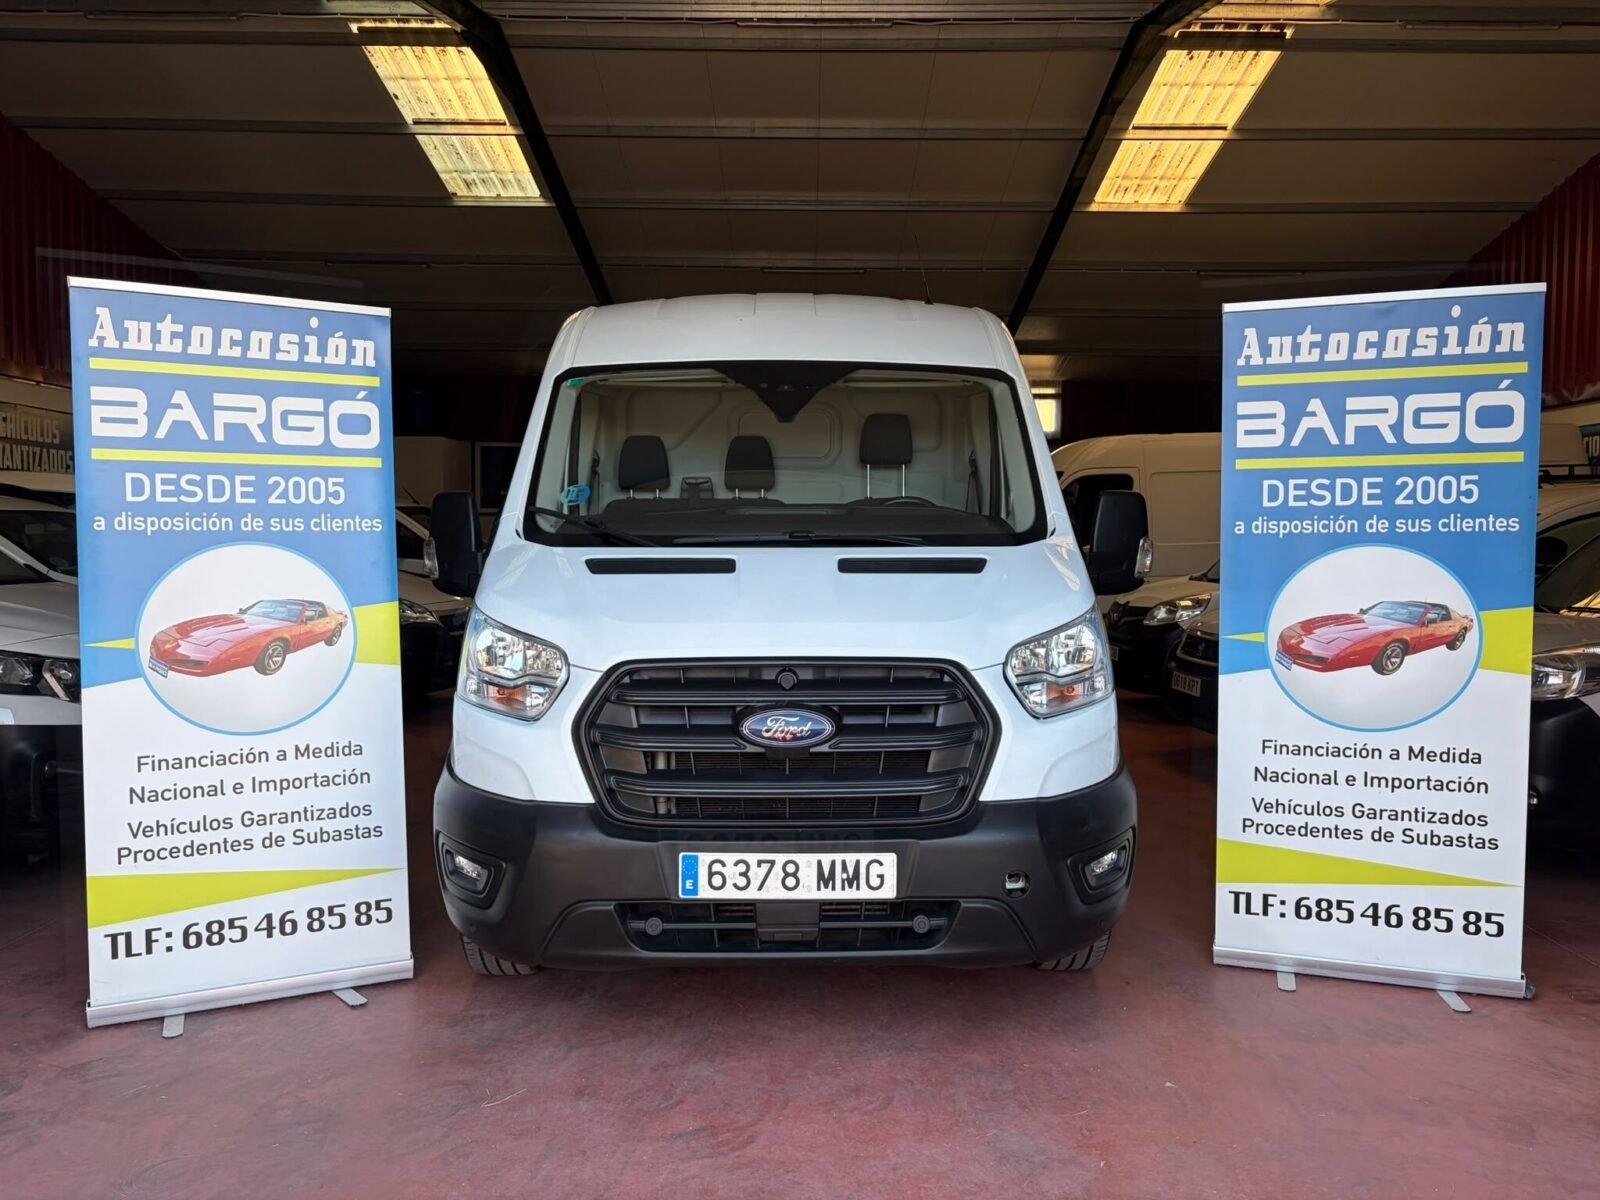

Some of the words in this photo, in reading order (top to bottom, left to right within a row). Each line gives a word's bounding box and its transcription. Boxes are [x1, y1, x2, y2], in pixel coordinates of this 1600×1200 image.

[88, 307, 375, 367] Autocasión
[1237, 305, 1524, 366] Autocasión
[90, 386, 380, 449] BARGÓ
[1236, 380, 1524, 448] BARGÓ
[126, 473, 256, 503] DESDE
[268, 476, 345, 504] 2005
[1263, 478, 1383, 507] DESDE
[1395, 475, 1478, 504] 2005
[94, 517, 105, 530] a
[115, 512, 232, 535] disposición
[241, 513, 263, 531] de
[270, 518, 304, 531] sus
[311, 514, 382, 531] clientes
[1235, 521, 1244, 534] a
[1252, 515, 1357, 538] disposición
[1366, 515, 1388, 532] de
[1396, 519, 1431, 532] sus
[1438, 514, 1519, 531] clientes
[761, 717, 810, 739] Ford
[137, 747, 269, 772] Financiación
[277, 750, 286, 761] a
[295, 741, 362, 760] Medida
[1262, 740, 1382, 759] Financiación
[1389, 749, 1399, 760] a
[1409, 746, 1481, 764] Medida
[130, 779, 226, 804] Nacional
[233, 783, 244, 794] e
[252, 768, 370, 795] Importación
[1255, 767, 1338, 785] Nacional
[1346, 775, 1356, 786] e
[1364, 772, 1488, 794] Importación
[128, 815, 233, 839] Vehículos
[241, 802, 372, 827] Garantizados
[1252, 797, 1344, 817] Vehículos
[1352, 803, 1488, 827] Garantizados
[118, 838, 254, 865] Procedentes
[262, 832, 285, 848] de
[293, 825, 383, 845] Subastas
[1243, 818, 1363, 840] Procedentes
[1371, 827, 1394, 842] de
[1402, 828, 1498, 850] Subastas
[686, 880, 693, 889] E
[708, 859, 800, 891] 6378
[817, 859, 884, 891] MMG
[104, 928, 172, 959] TLF:
[183, 917, 247, 949] 685
[254, 910, 297, 938] 46
[307, 904, 346, 932] 85
[355, 898, 392, 926] 85
[1229, 891, 1286, 918] TLF:
[1295, 897, 1354, 923] 685
[1360, 903, 1403, 928] 46
[1413, 907, 1453, 933] 85
[1463, 911, 1504, 937] 85
